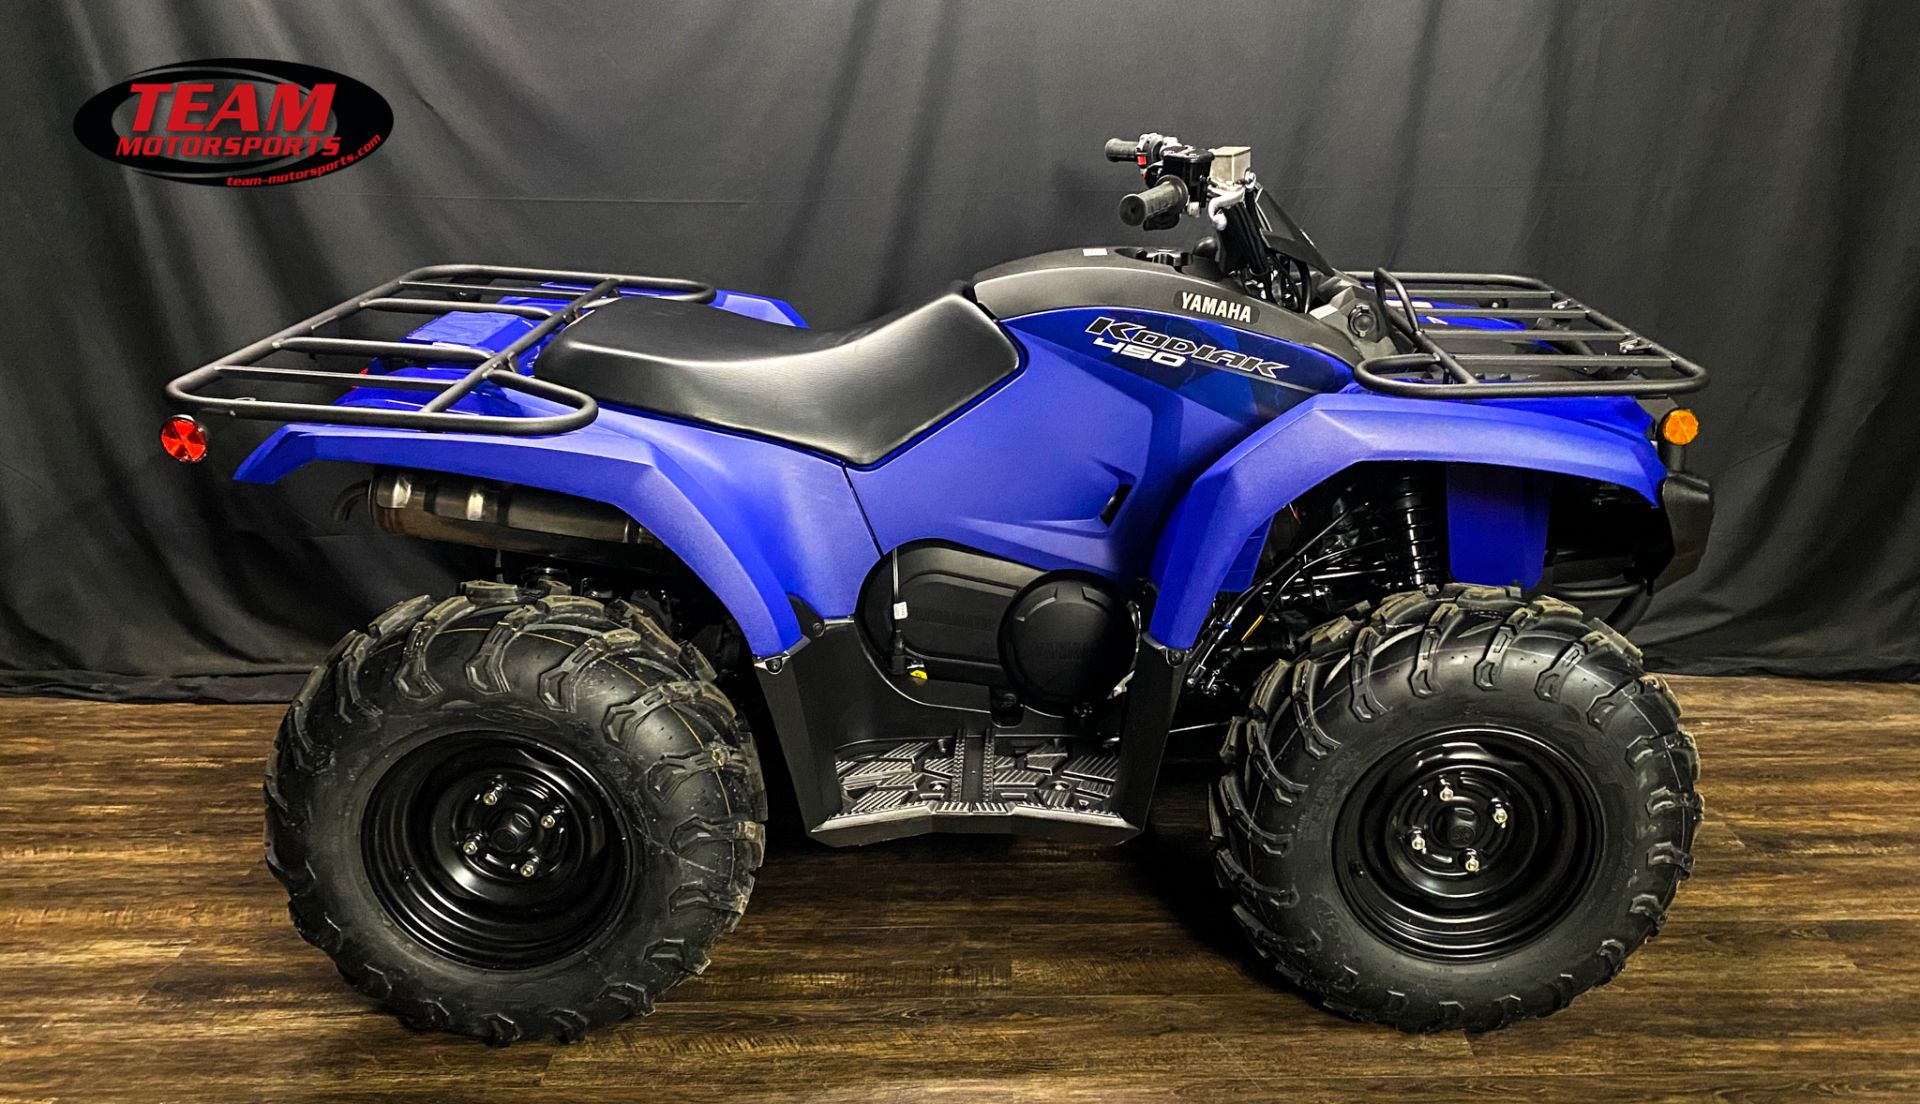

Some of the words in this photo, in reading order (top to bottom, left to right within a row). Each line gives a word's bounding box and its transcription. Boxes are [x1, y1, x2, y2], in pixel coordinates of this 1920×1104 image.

[1181, 291, 1251, 323] YAMAHA
[1085, 316, 1290, 379] KODIAK
[1093, 337, 1187, 368] 450
